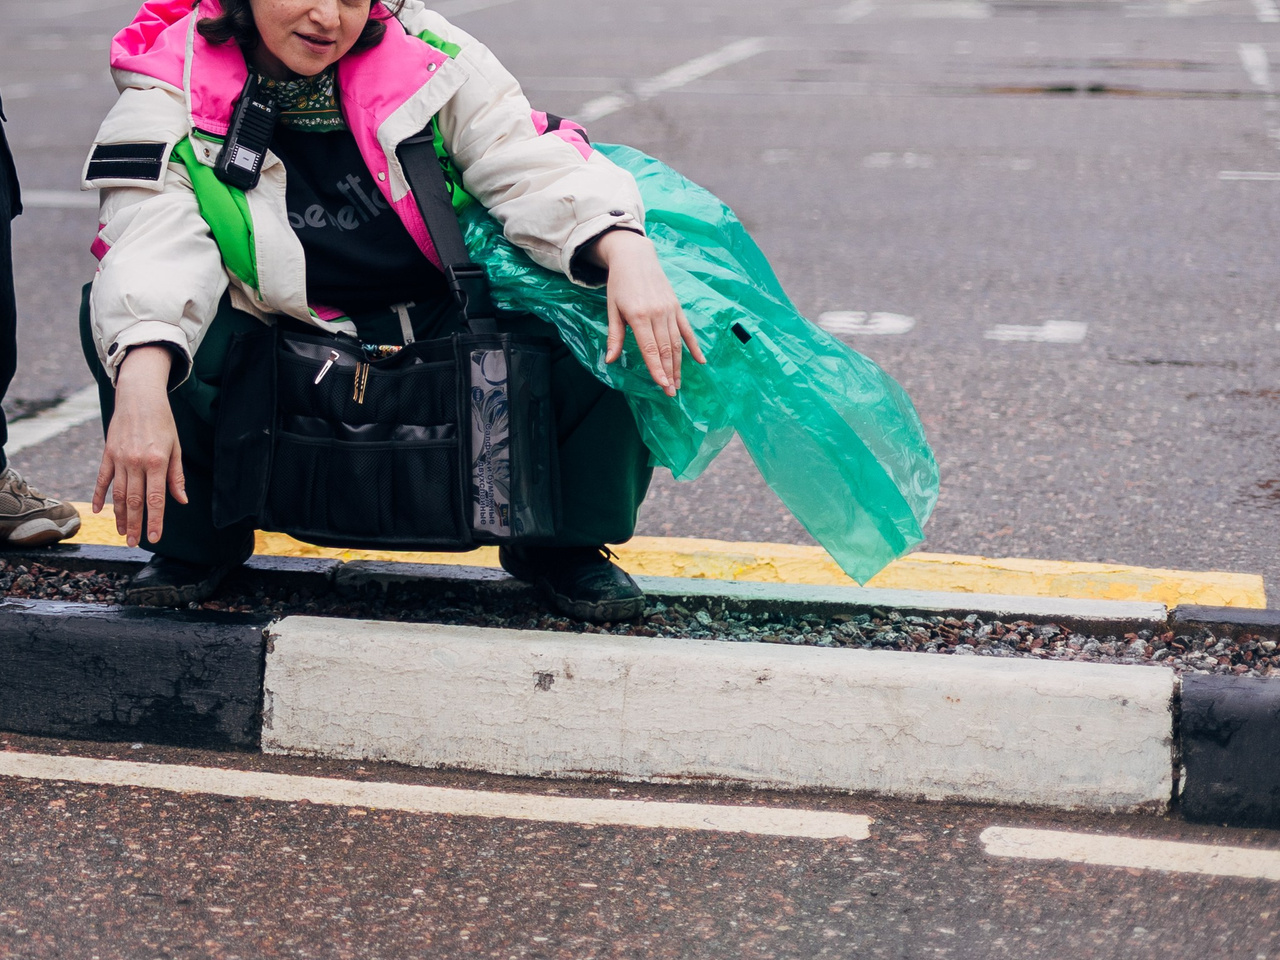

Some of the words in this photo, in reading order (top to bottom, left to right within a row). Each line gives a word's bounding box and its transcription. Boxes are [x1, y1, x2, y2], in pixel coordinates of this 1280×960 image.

[484, 423, 493, 472] Салфетки
[477, 460, 486, 525] двухслойные
[486, 473, 496, 525] бумажные
